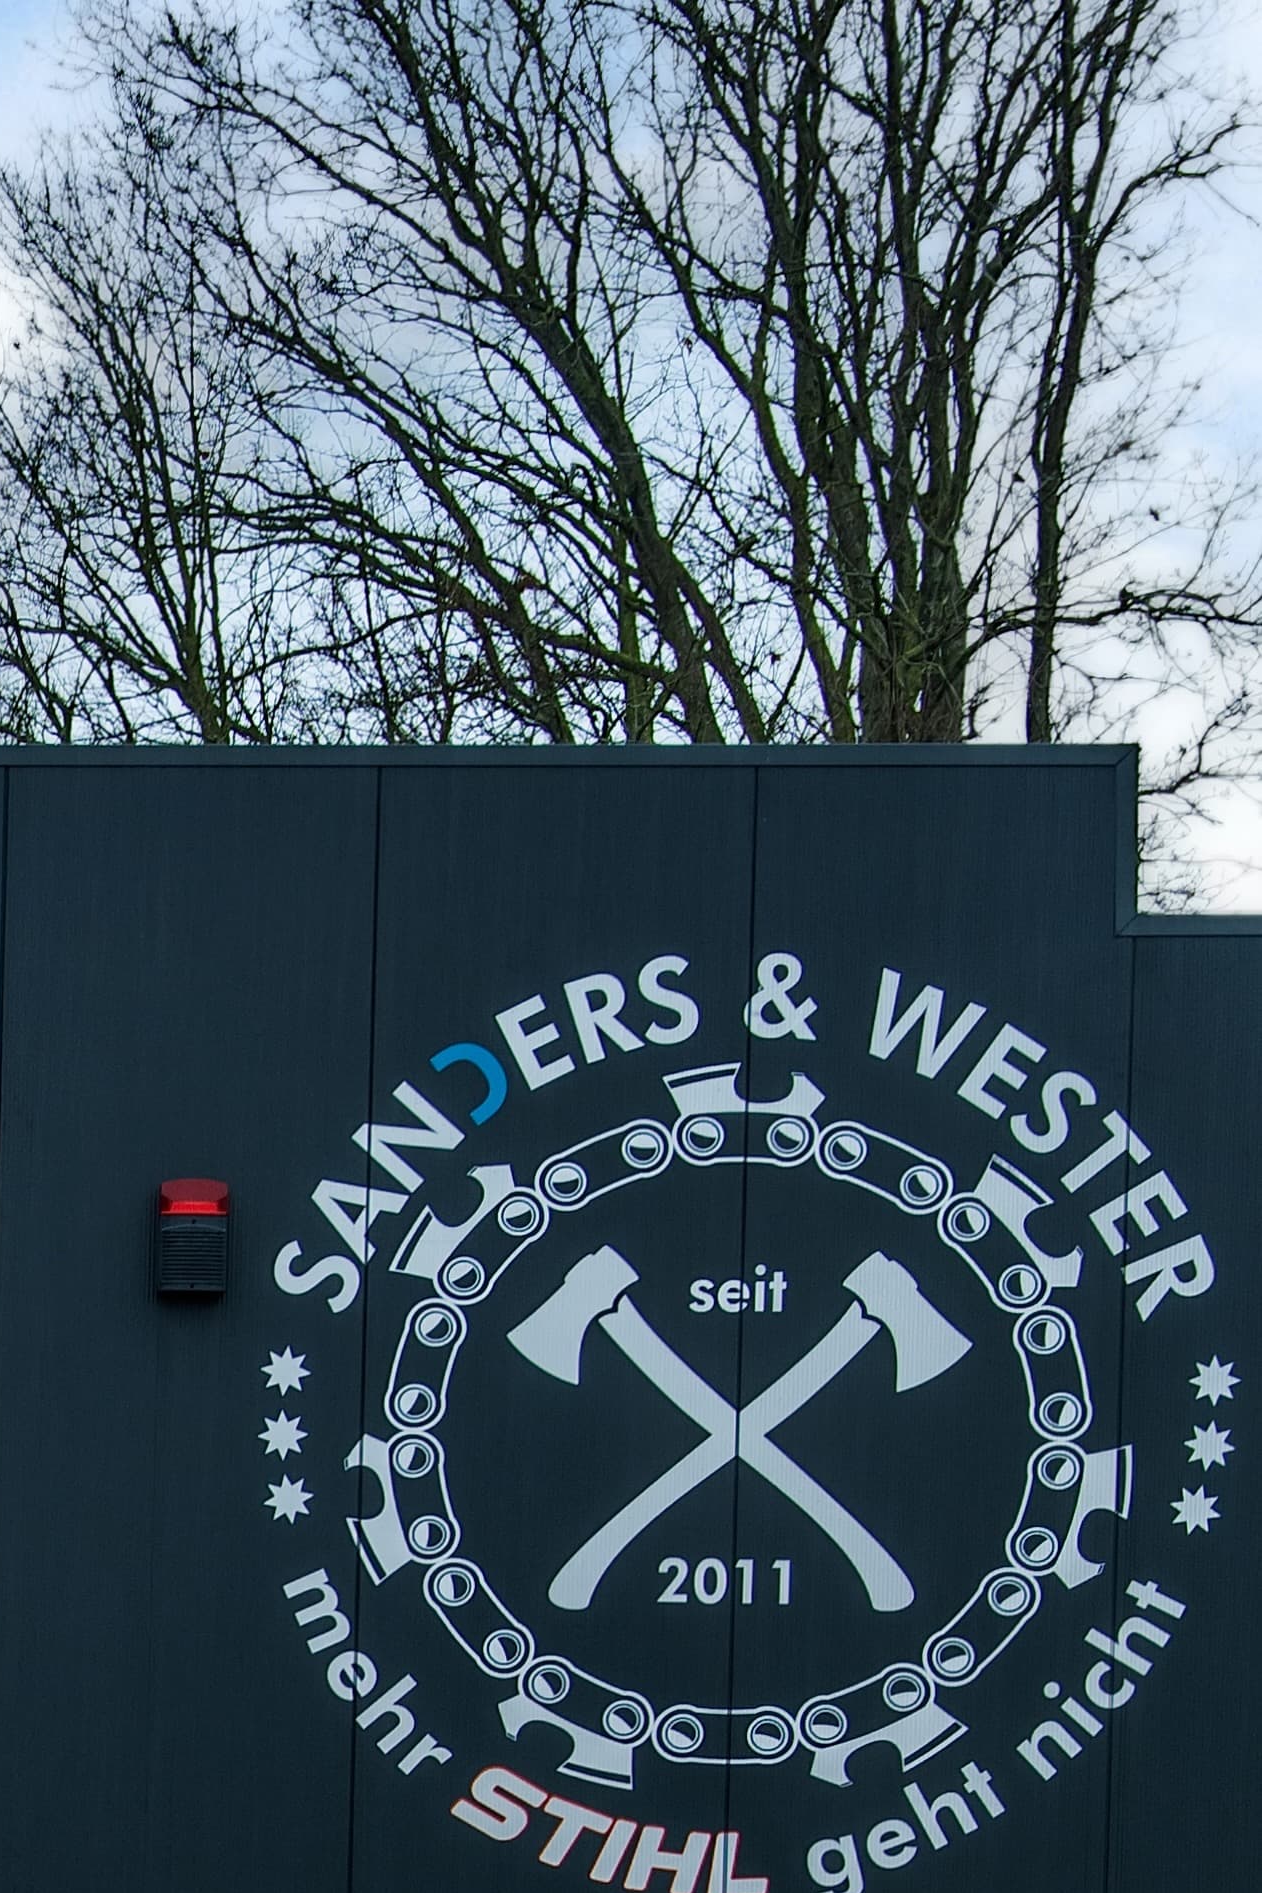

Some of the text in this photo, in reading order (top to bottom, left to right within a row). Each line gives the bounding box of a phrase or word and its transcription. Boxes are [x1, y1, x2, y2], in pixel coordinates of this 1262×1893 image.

[273, 952, 1216, 1323] SANDERS & WESTER
[688, 1264, 788, 1314] seit
[657, 1556, 793, 1606] 2011
[281, 1567, 454, 1777] mehr
[1015, 1577, 1189, 1781] nicht
